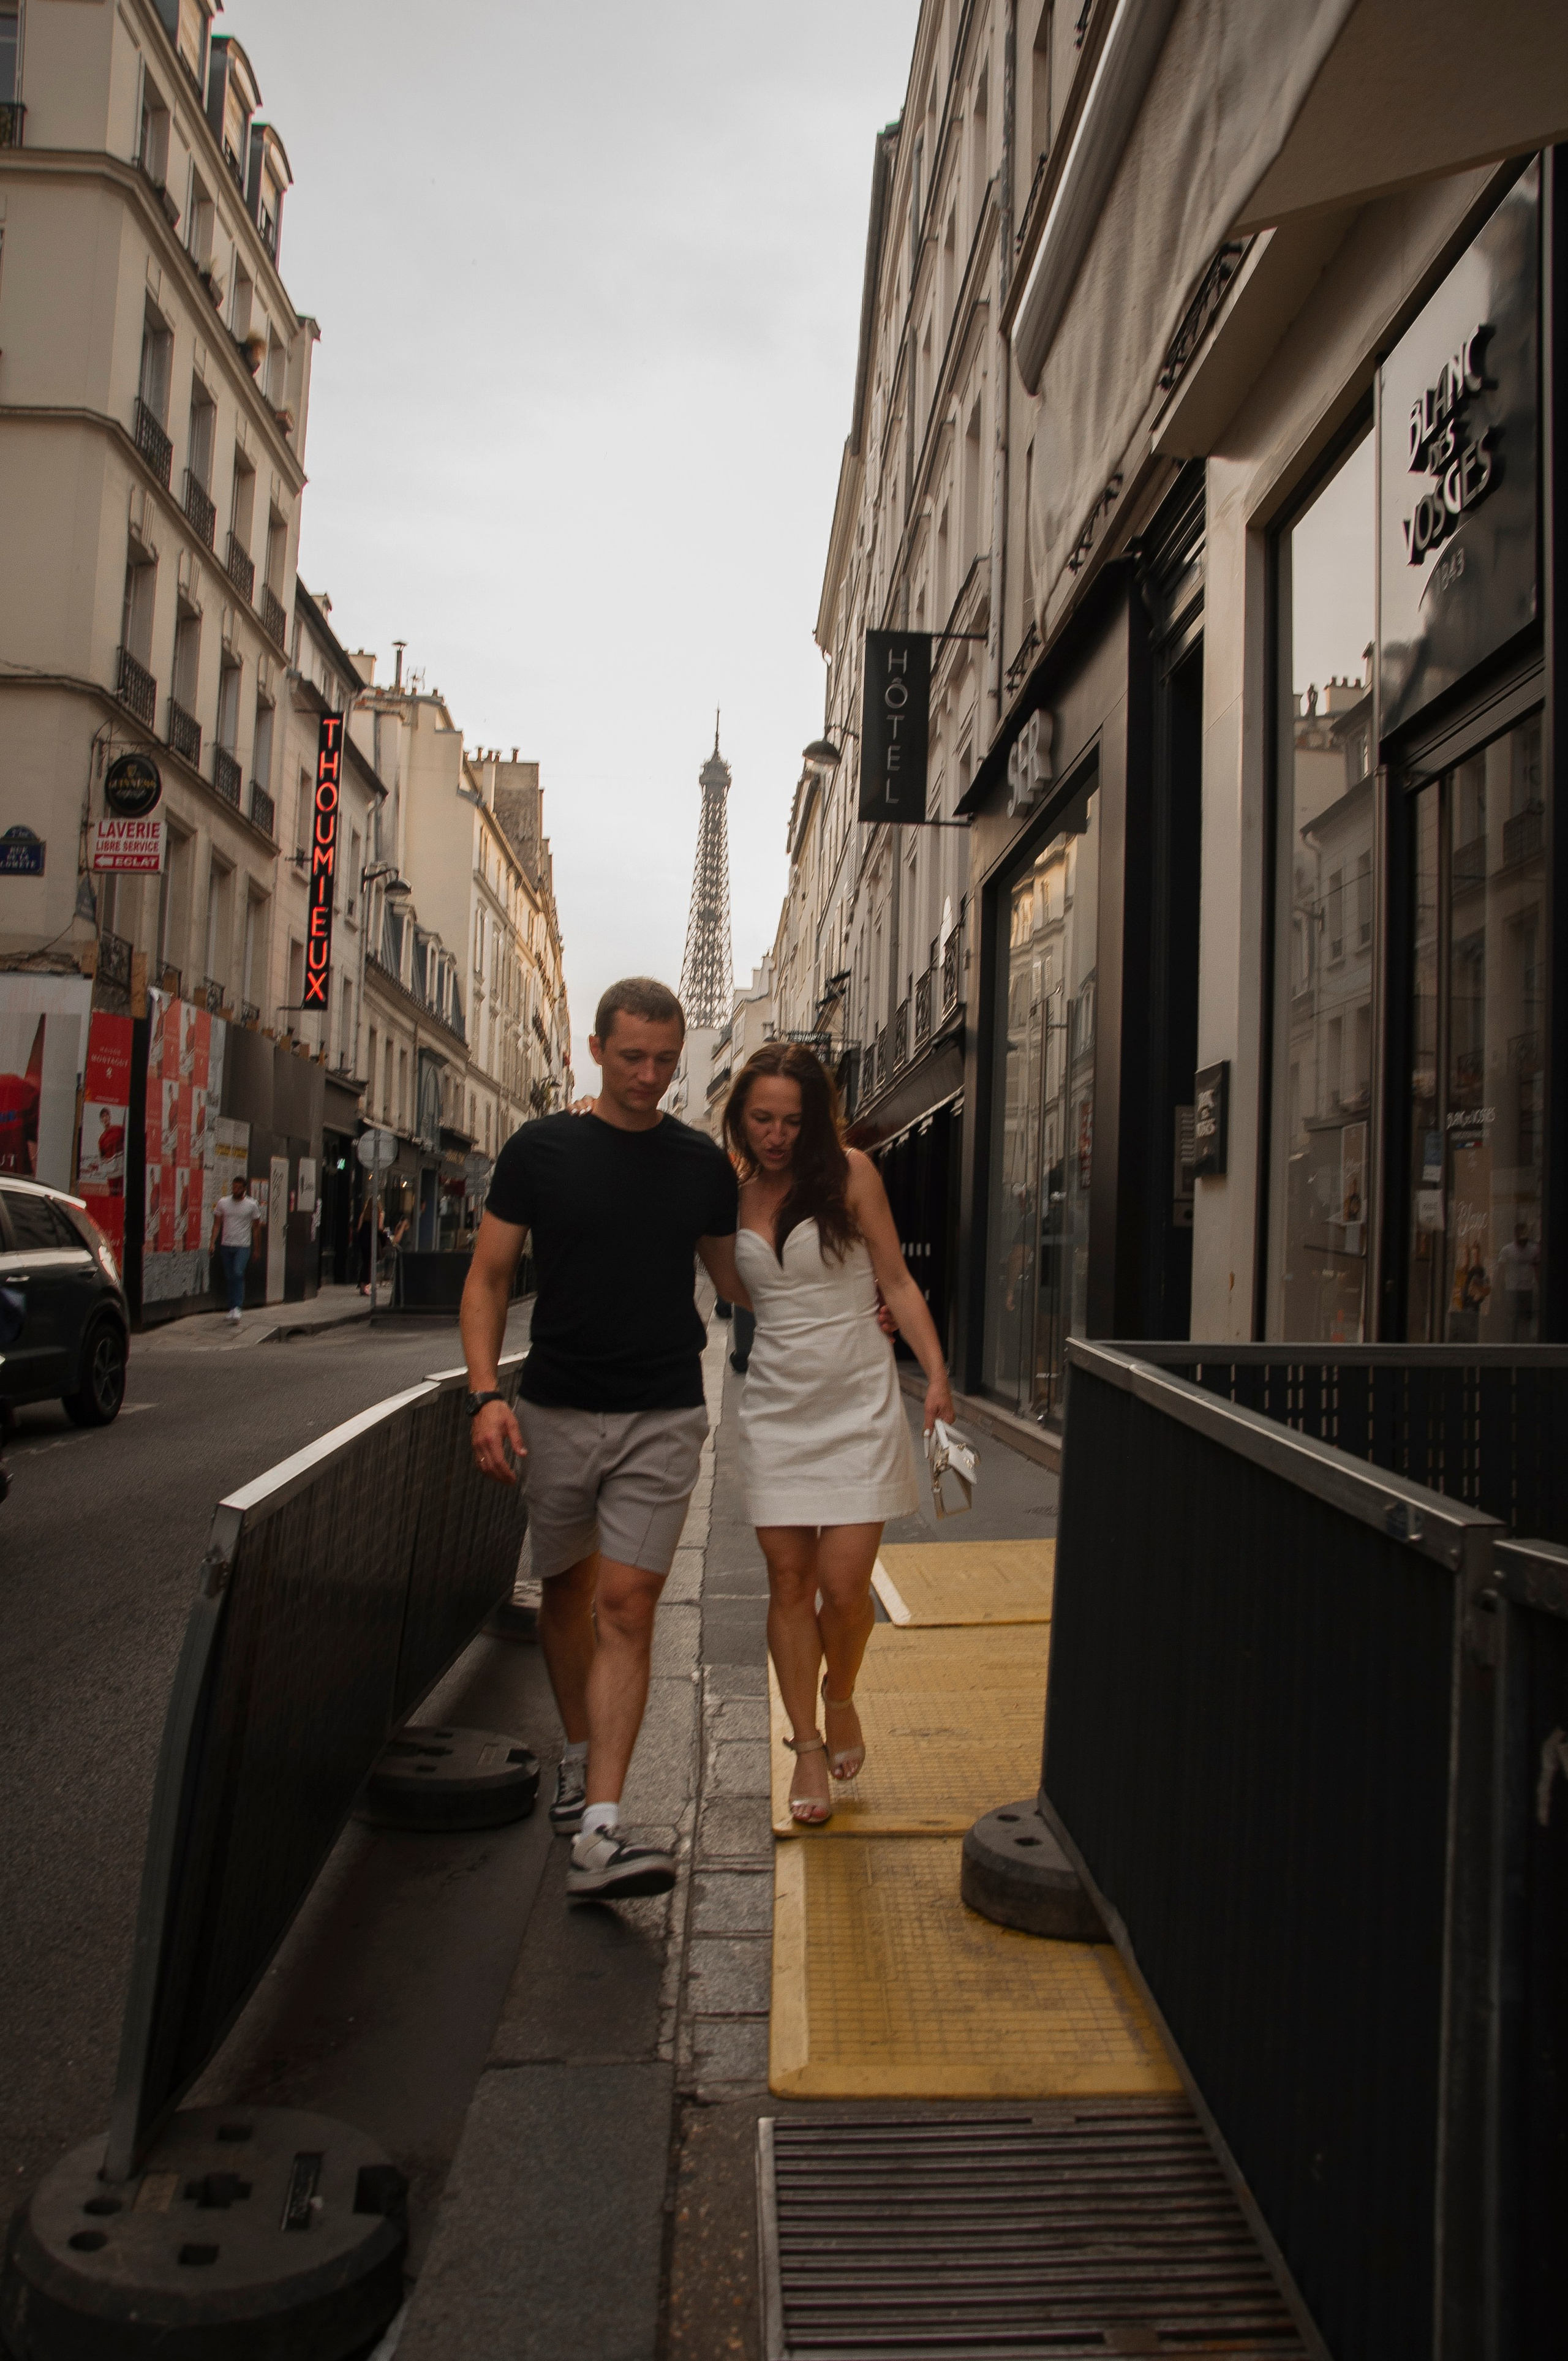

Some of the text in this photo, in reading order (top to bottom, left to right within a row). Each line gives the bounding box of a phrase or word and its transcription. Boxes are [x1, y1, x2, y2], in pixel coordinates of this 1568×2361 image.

[1407, 324, 1482, 473] BLANC
[1428, 417, 1455, 476] DES
[1403, 427, 1492, 566] VOSGES
[884, 648, 908, 804] HÔTEL
[96, 840, 159, 853] LIBRE SERVICE
[97, 821, 161, 838] LAVERIE
[306, 718, 341, 1001] THOUMIEUX
